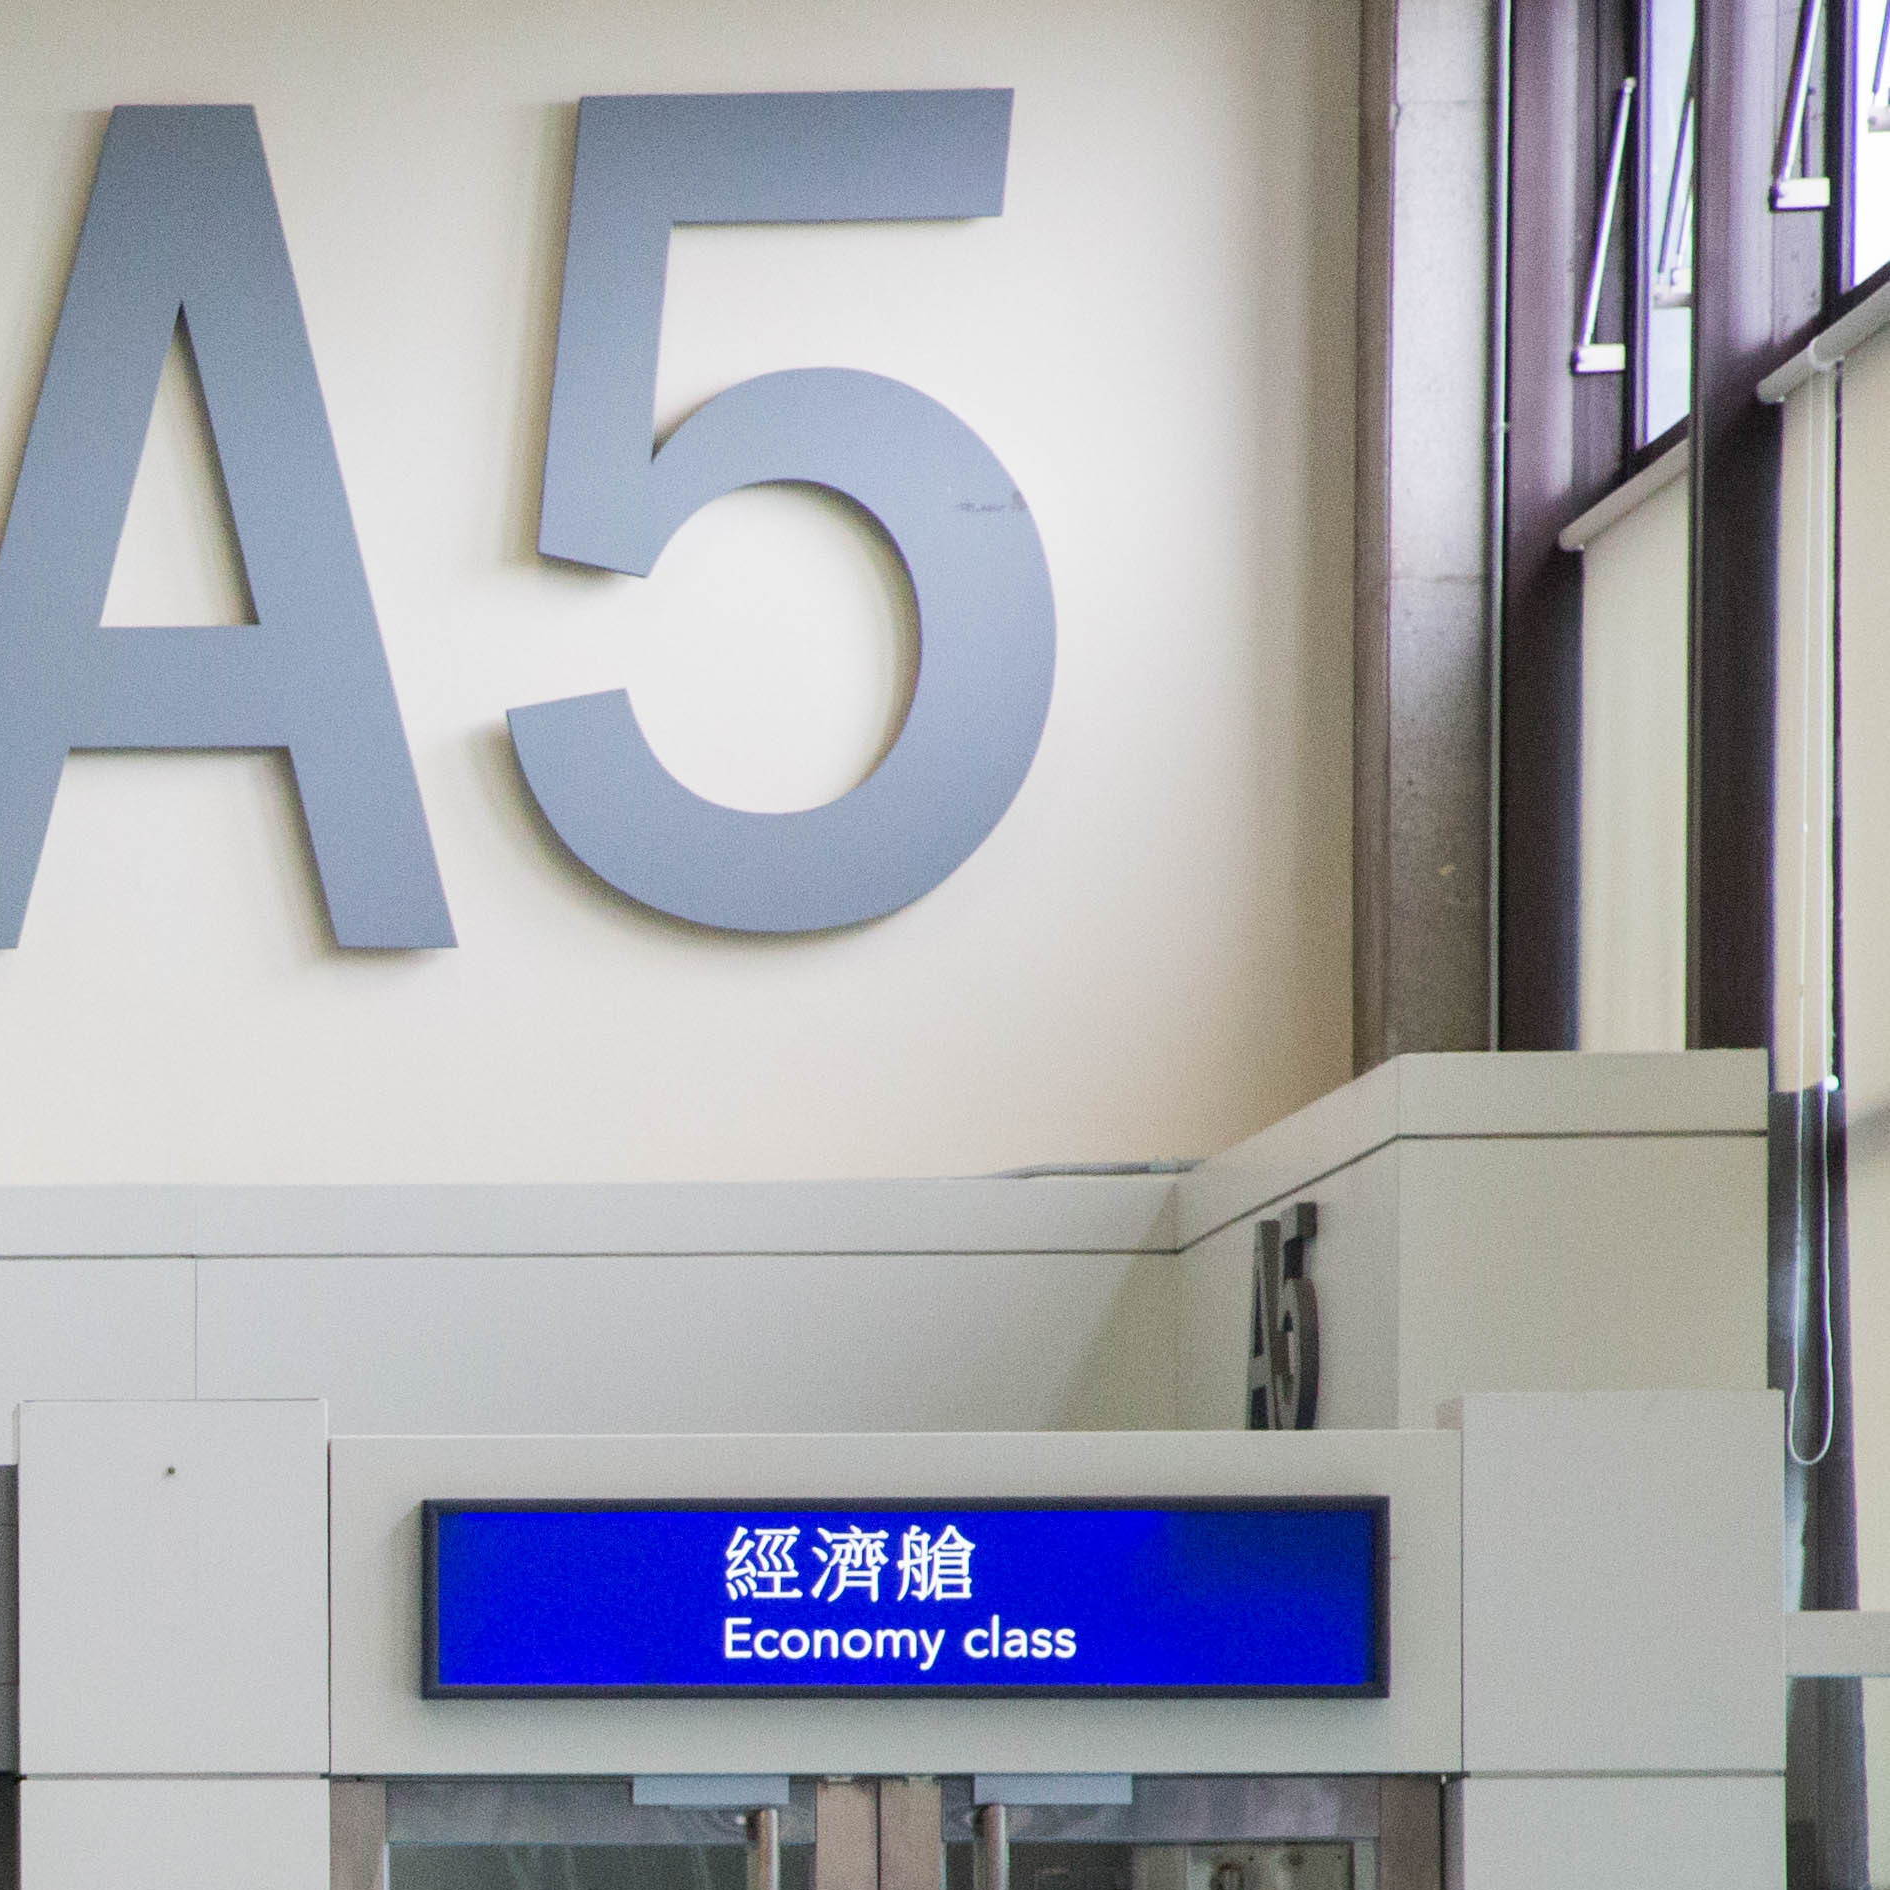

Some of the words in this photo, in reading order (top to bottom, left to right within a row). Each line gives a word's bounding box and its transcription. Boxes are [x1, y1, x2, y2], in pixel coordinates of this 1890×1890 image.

[724, 1525, 976, 1602] 經濟艙
[724, 1617, 944, 1671] Economy
[963, 1615, 1077, 1659] class
